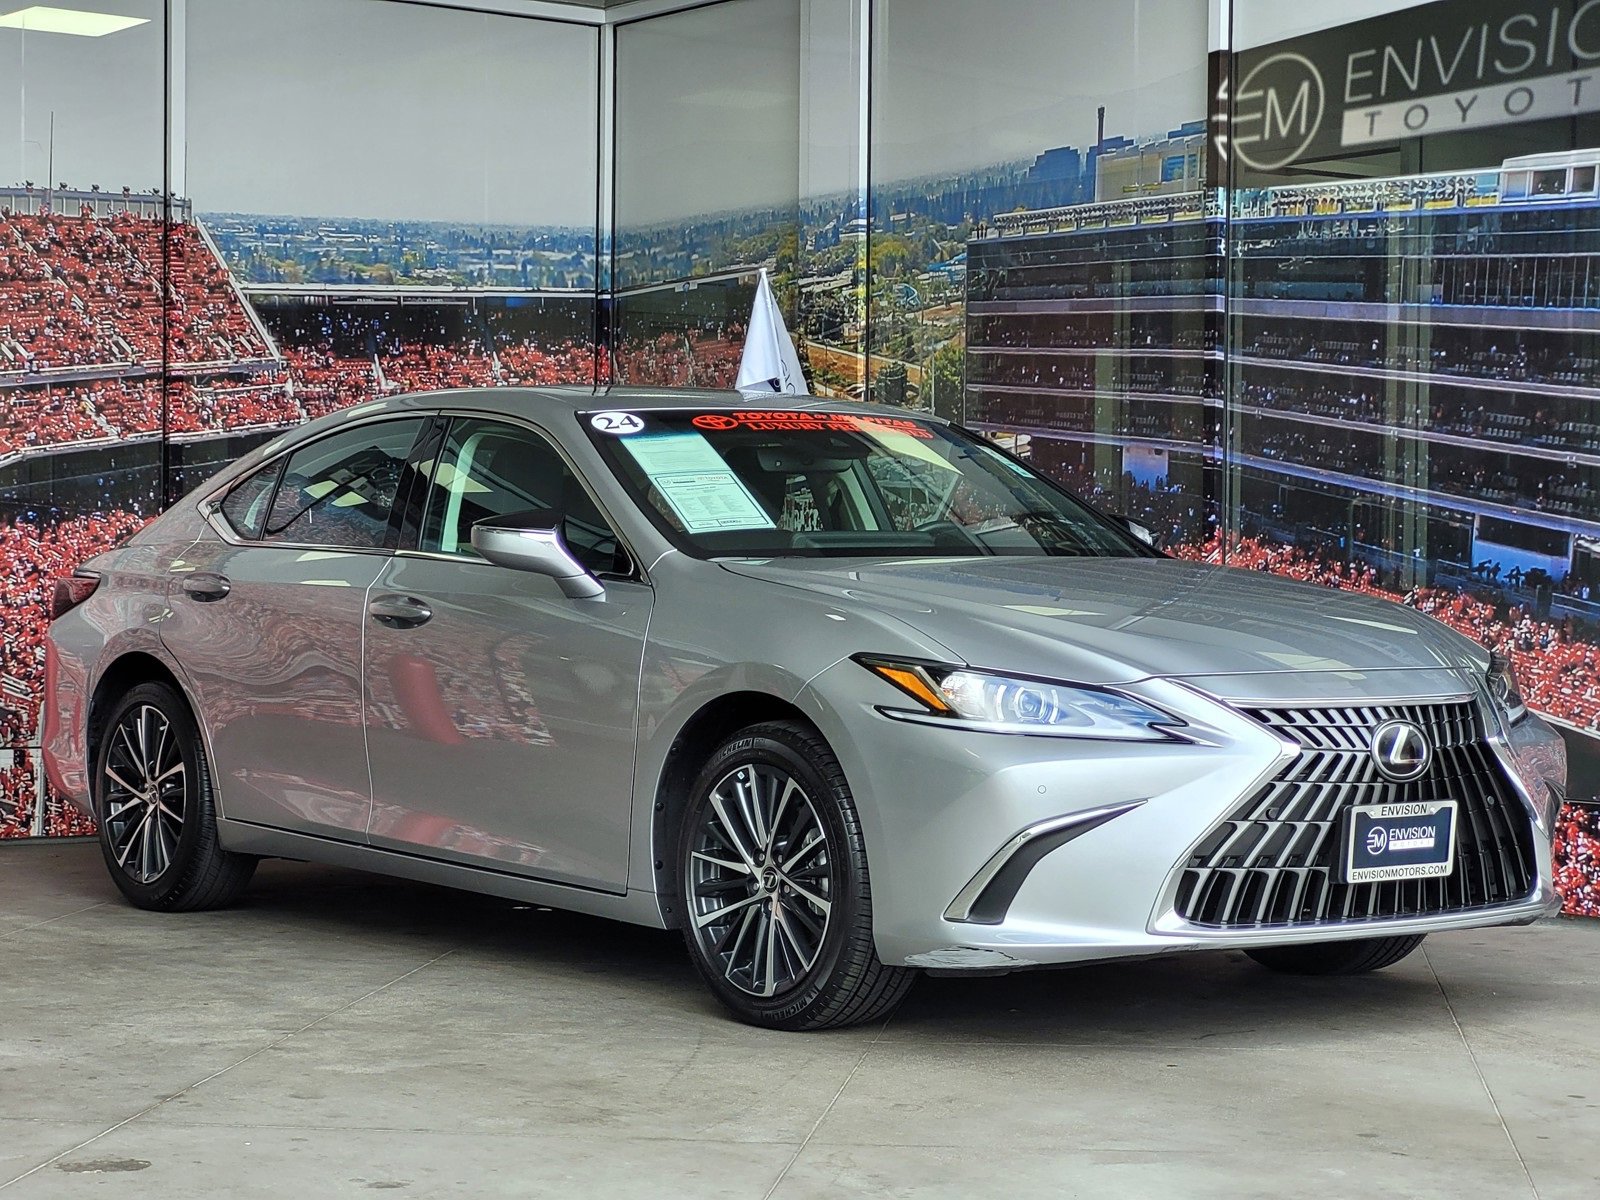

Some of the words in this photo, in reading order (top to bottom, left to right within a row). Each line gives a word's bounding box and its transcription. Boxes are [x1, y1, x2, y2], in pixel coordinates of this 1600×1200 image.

[596, 415, 639, 430] 24
[732, 412, 814, 420] TOYOTA
[746, 422, 826, 431] LUXURY
[1381, 803, 1428, 816] ENVISION
[1389, 826, 1436, 841] ENVISION
[1352, 864, 1448, 881] ENVISIONMOTORS.COM
